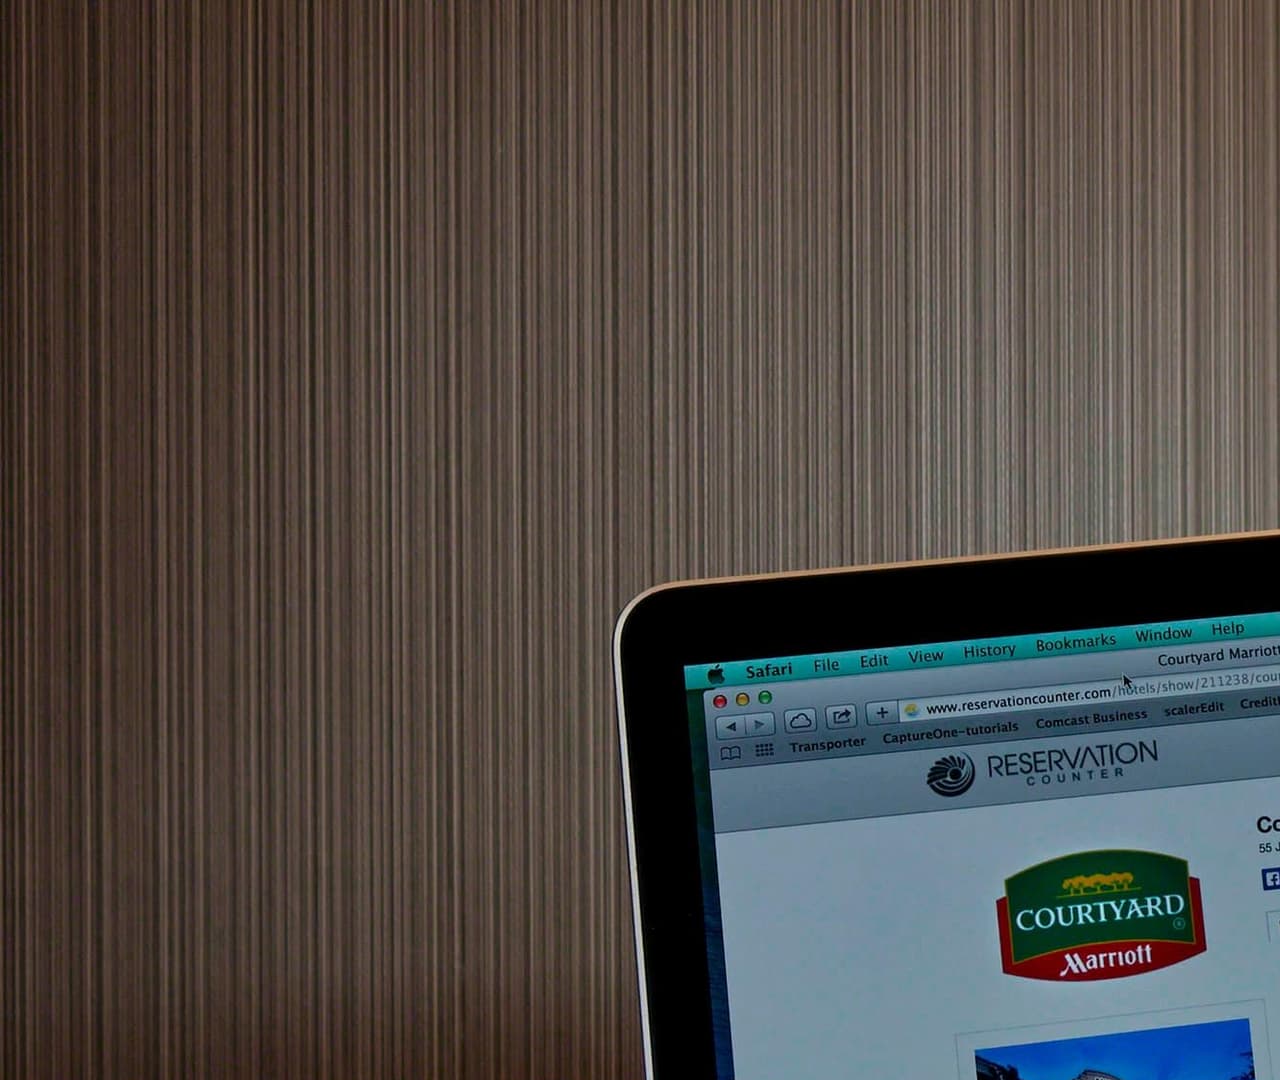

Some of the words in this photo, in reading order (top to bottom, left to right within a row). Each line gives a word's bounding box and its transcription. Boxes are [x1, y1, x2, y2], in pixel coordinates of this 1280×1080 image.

[745, 661, 793, 679] Safari
[813, 657, 839, 672] File
[859, 653, 889, 668] Edit
[907, 650, 944, 663] View
[963, 644, 1016, 658] History
[1035, 632, 1117, 652] Bookmarks
[1135, 626, 1193, 642] Window
[1211, 620, 1245, 636] Help
[1157, 648, 1225, 671] Courtyard
[1035, 713, 1092, 729] Comcast
[1092, 709, 1148, 724] Business
[1163, 699, 1225, 717] scalerEdit
[882, 720, 1019, 745] CaptureOne-tutorials
[788, 735, 867, 754] Transporter
[986, 739, 1158, 778] RESERVATION
[1025, 766, 1124, 787] COUNTER
[1258, 841, 1273, 854] 55
[1015, 894, 1184, 931] COURTYARD
[1059, 943, 1152, 977] Marriott
